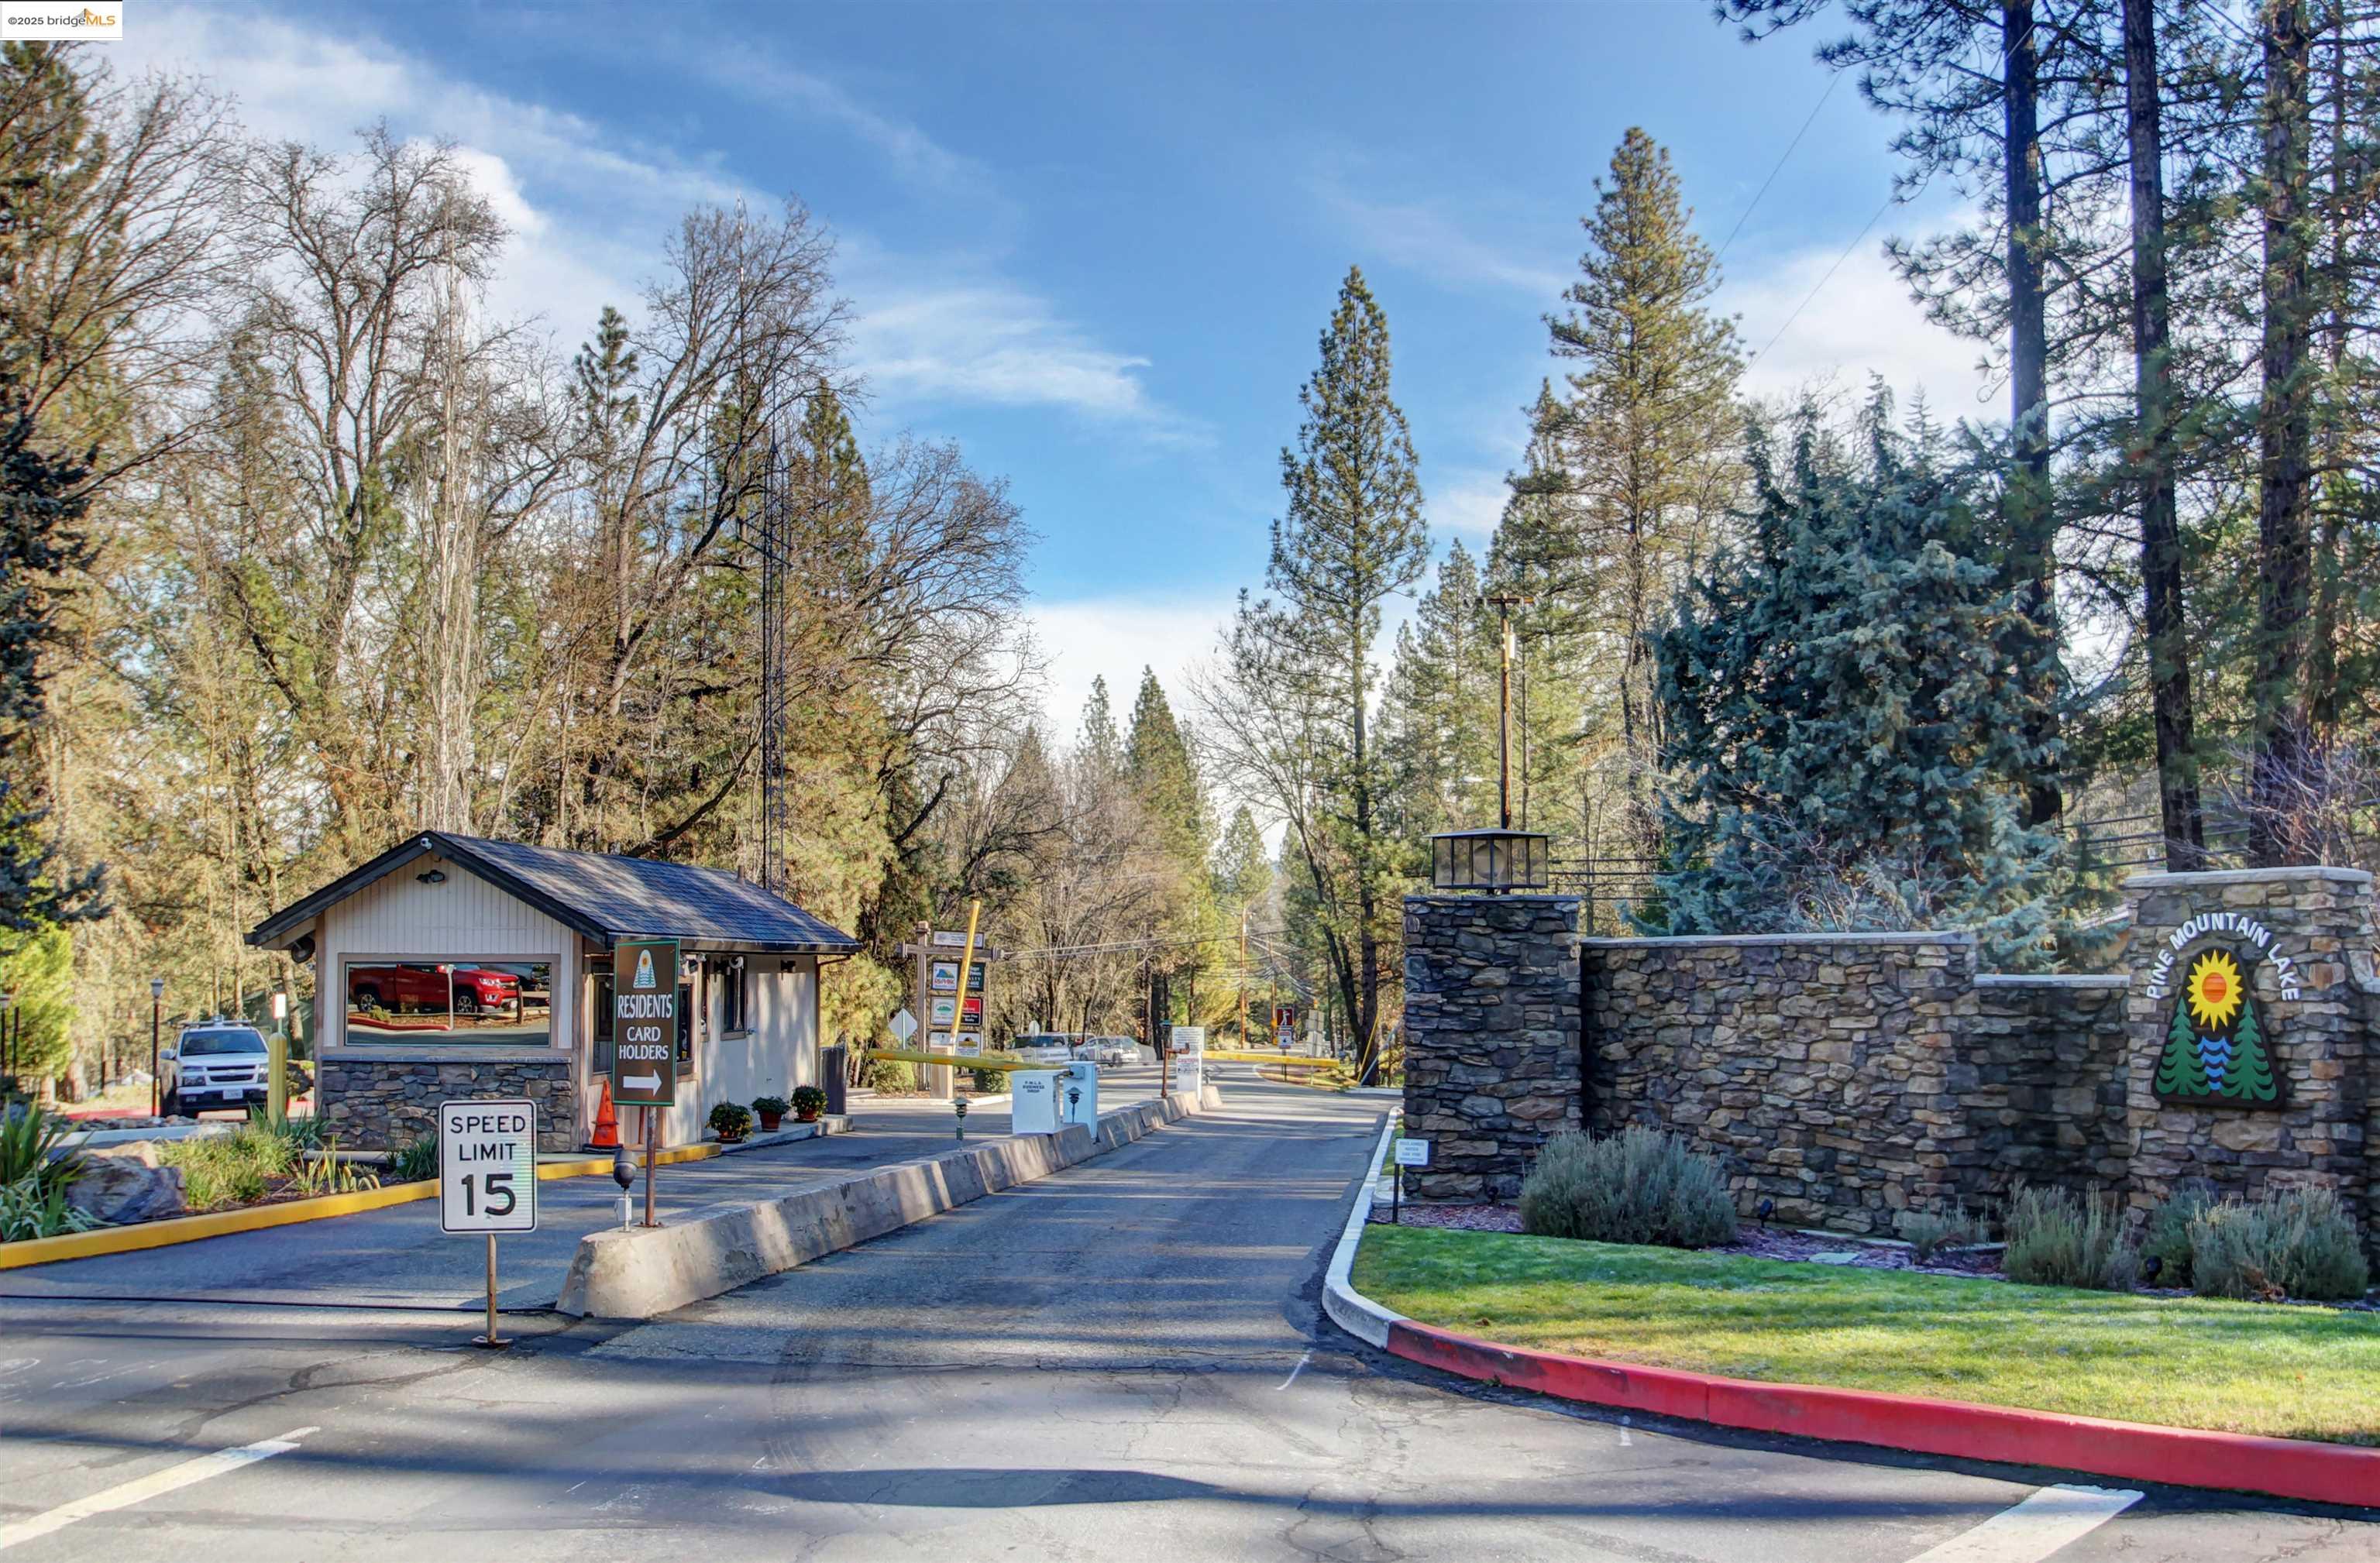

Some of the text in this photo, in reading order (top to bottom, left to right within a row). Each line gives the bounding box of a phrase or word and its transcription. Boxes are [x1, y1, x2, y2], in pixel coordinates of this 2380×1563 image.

[2147, 912, 2299, 1001] PINE MOUNTAIN LAKE
[617, 994, 672, 1019] RESIDENTS
[627, 1026, 662, 1042] CARD
[618, 1044, 669, 1060] HOLDERS
[450, 1115, 526, 1134] SPEED
[459, 1142, 517, 1161] LIMIT
[461, 1173, 516, 1216] 15
